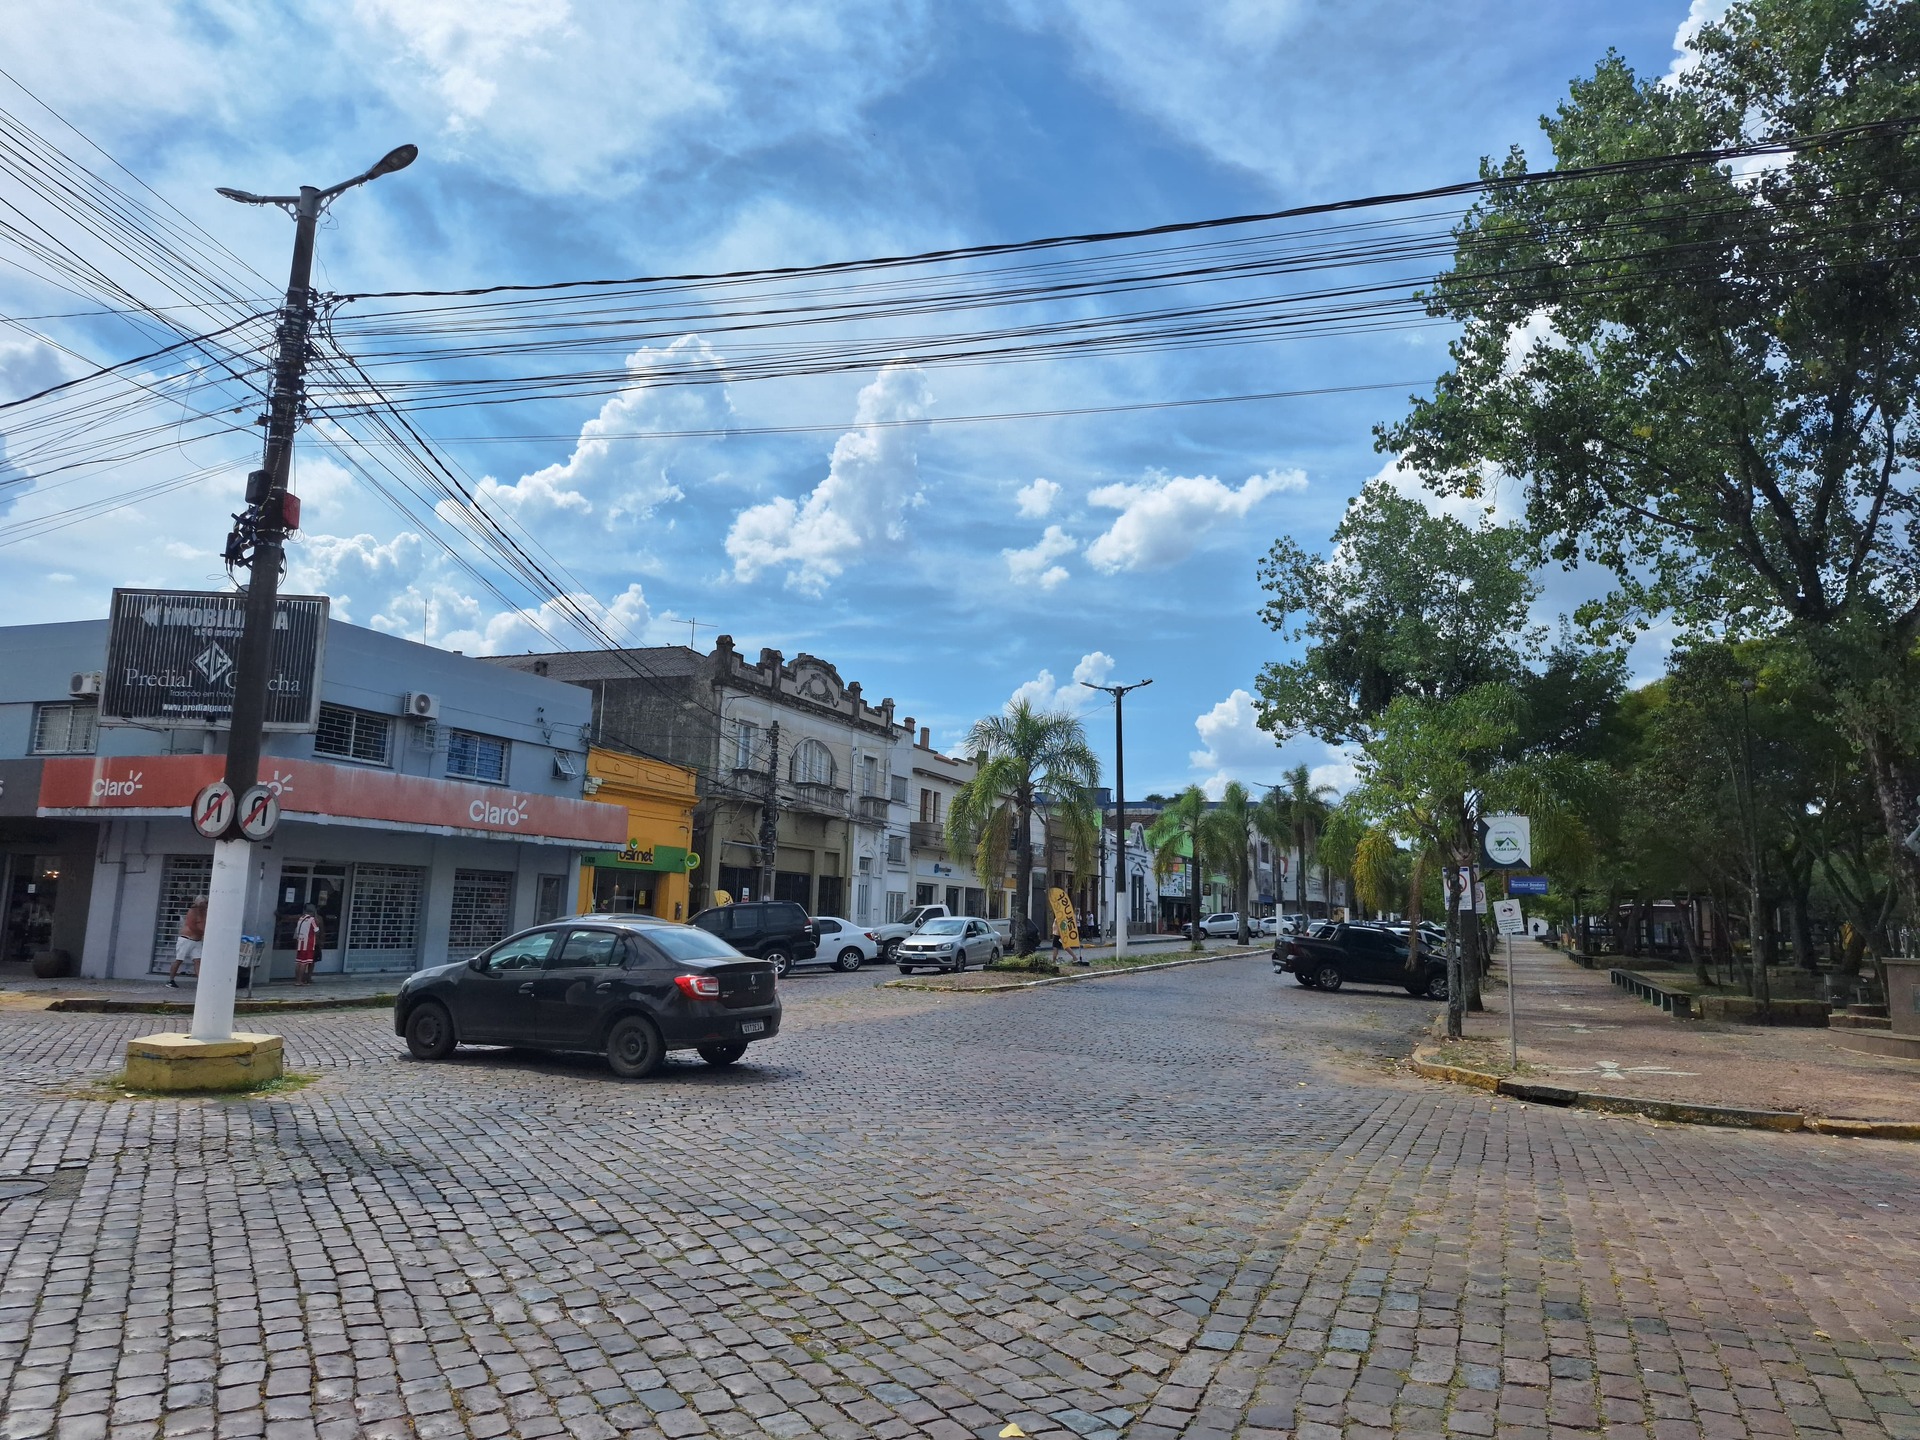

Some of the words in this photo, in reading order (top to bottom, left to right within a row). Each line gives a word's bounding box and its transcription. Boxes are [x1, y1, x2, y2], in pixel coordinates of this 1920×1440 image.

[163, 606, 289, 630] IMOBILIA
[124, 668, 193, 688] Predial
[162, 703, 233, 713] www.predialgauch
[93, 777, 135, 797] Claro
[469, 799, 520, 826] Claro
